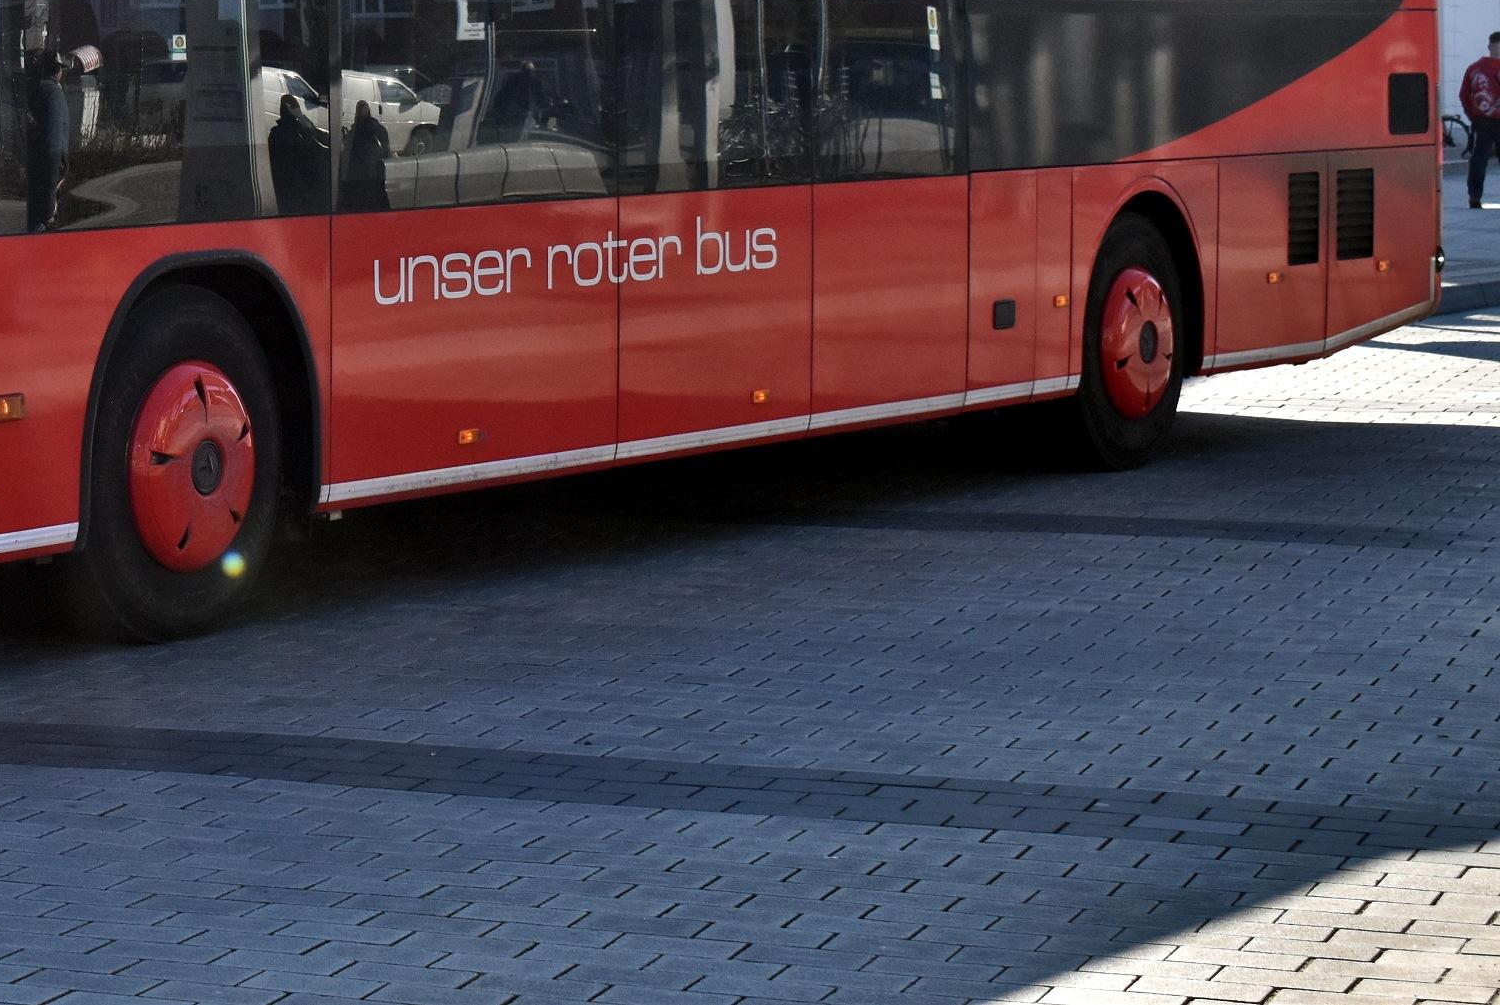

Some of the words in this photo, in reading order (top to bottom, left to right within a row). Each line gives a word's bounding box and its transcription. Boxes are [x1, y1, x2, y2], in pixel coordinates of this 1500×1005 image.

[373, 247, 531, 305] unser
[547, 231, 682, 289] roter
[696, 216, 778, 275] bus
